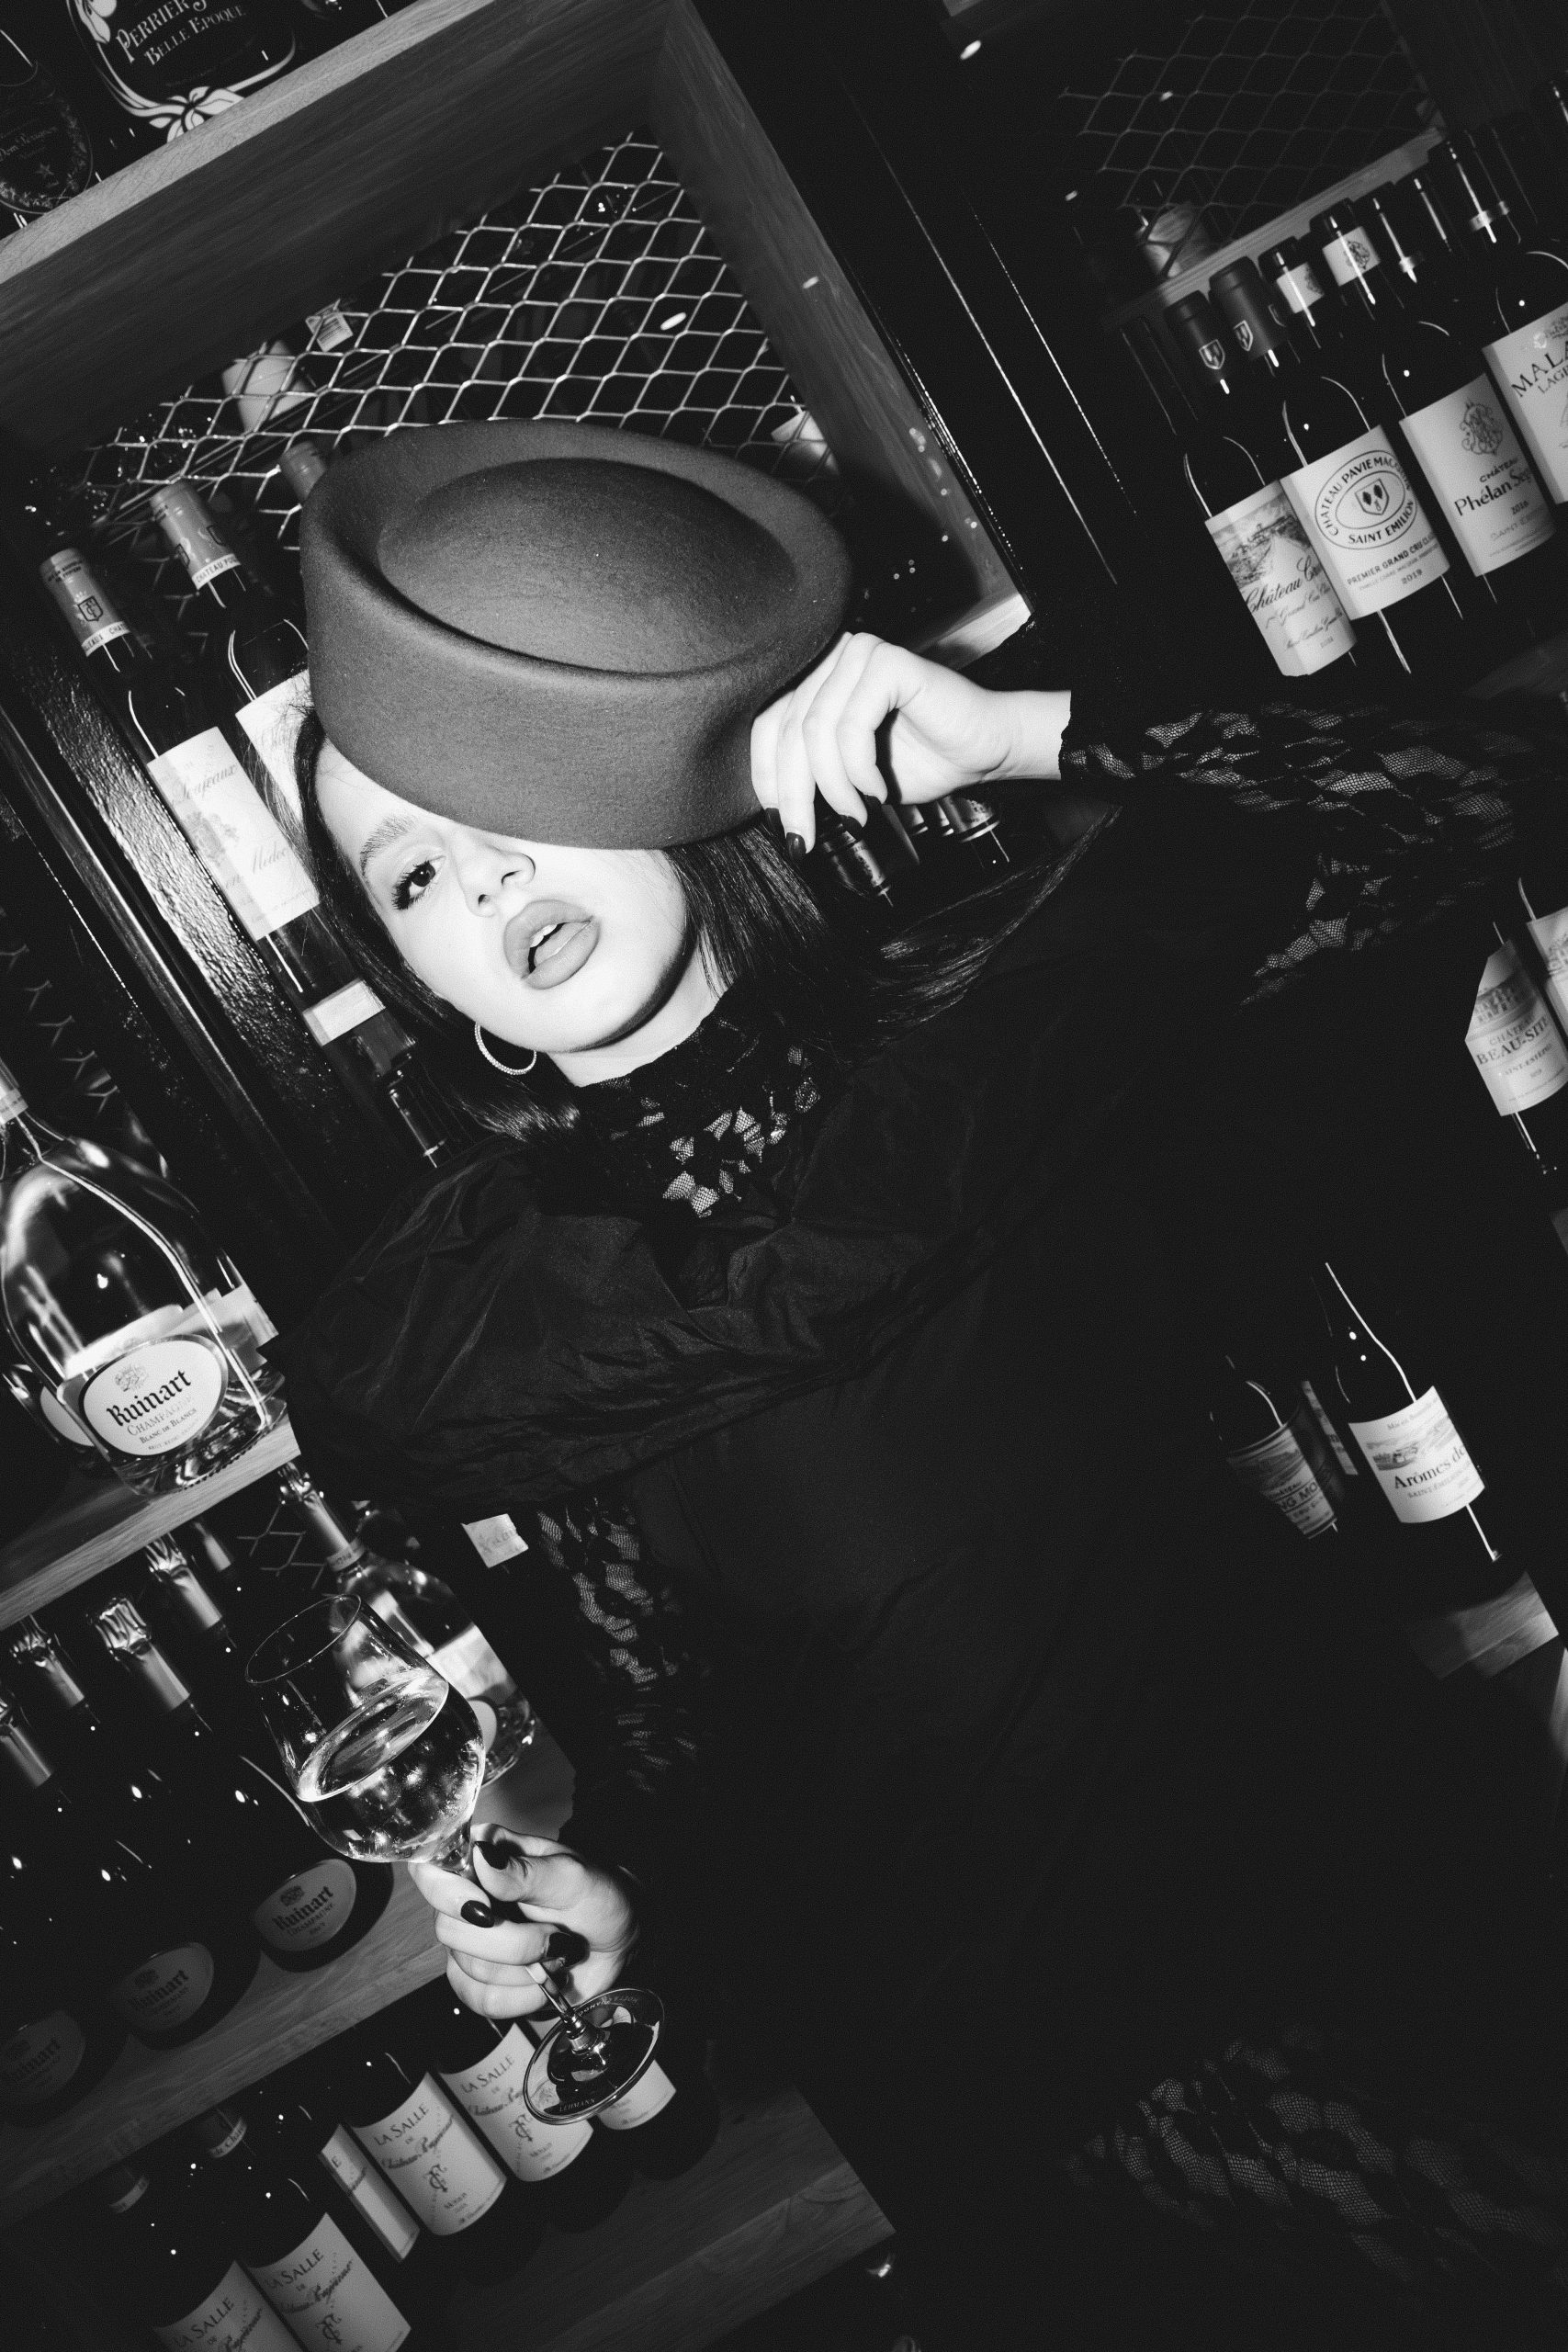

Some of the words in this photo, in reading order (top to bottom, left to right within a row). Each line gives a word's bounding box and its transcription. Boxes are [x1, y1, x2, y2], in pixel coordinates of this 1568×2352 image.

[144, 28, 190, 65] BELLE
[1320, 482, 1342, 537] CHATEAU
[1341, 458, 1373, 484] PAVIE
[1454, 481, 1513, 516] Phélan
[1348, 530, 1386, 545] SAINT
[1384, 500, 1415, 537] EMILION
[196, 558, 223, 584] CHATEAU
[1347, 564, 1382, 586] PREMIER
[1382, 549, 1409, 569] GRAND
[106, 1369, 191, 1427] Ruinart
[271, 1885, 334, 1931] Ruinart
[477, 2056, 515, 2087] SALLE
[374, 2133, 392, 2146] LA
[390, 2103, 430, 2139] SALLE
[280, 2248, 325, 2284] SALLE
[190, 2298, 235, 2339] SALLE
